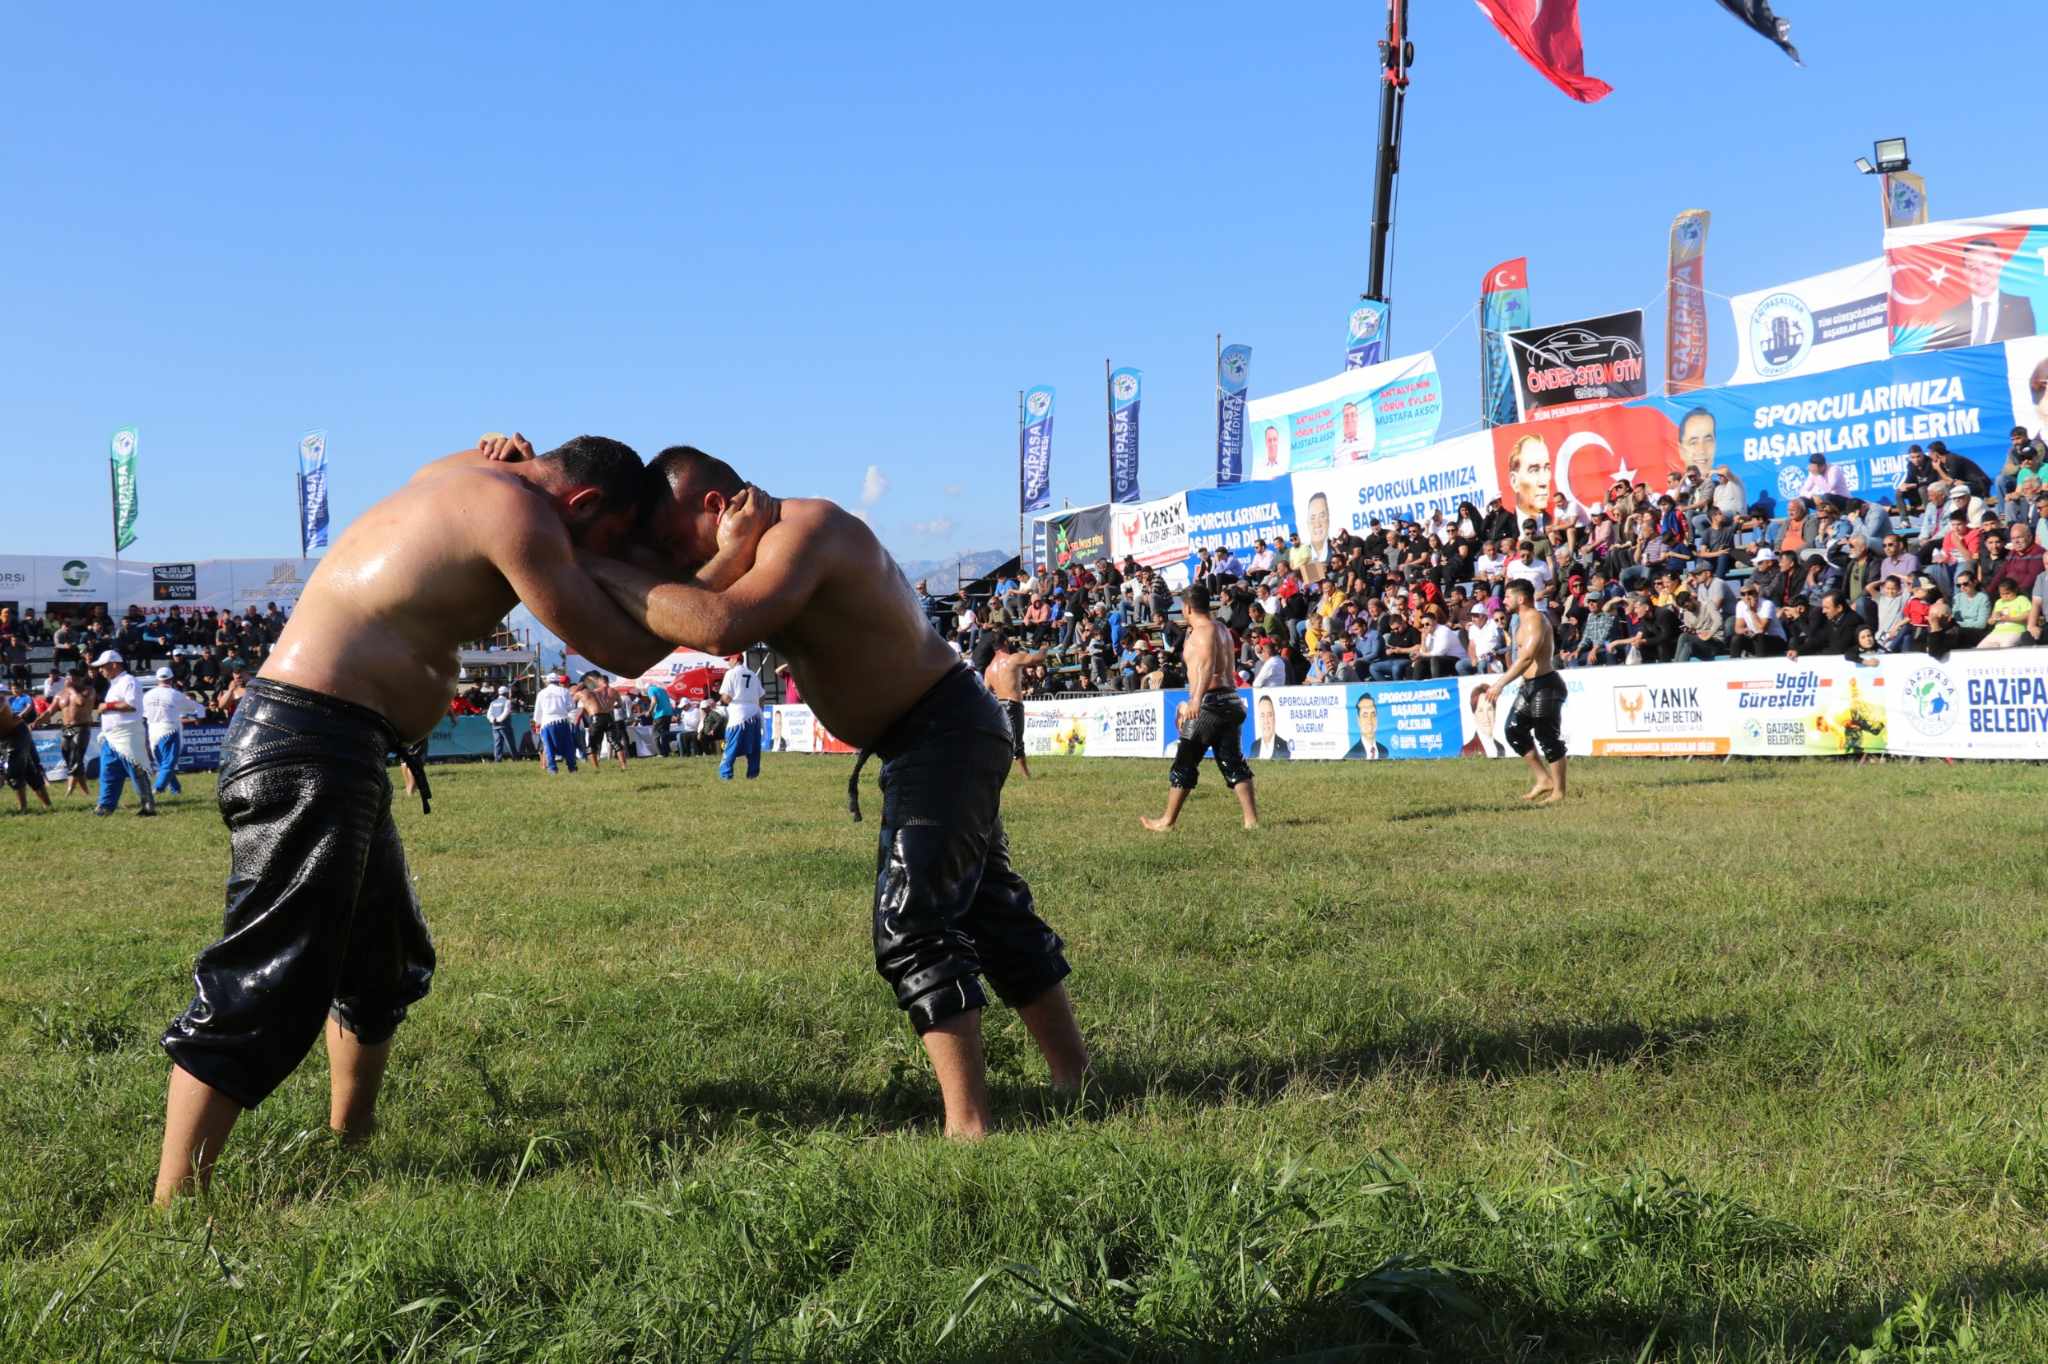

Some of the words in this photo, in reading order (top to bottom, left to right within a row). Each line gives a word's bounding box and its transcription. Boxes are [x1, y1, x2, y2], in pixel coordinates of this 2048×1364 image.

[1376, 411, 1414, 424] MUSTAFA
[1415, 403, 1441, 418] AKSOY
[1753, 376, 1966, 430] SPORCULARIMIZA
[1743, 422, 1870, 465] BAŞARILAR
[1874, 405, 1981, 446] DİLERİM
[1359, 465, 1477, 505] SPORCULARIMIZA
[1187, 502, 1281, 532] SPORCULARIMIZA
[741, 674, 751, 688] 7
[1776, 671, 1818, 692] Yağlı
[1279, 696, 1339, 707] SPORCULARIMIZA
[1649, 687, 1699, 708] YANIK
[1739, 690, 1816, 709] Güreşleri
[1644, 711, 1669, 724] HAZIR
[1672, 710, 1703, 724] BETON
